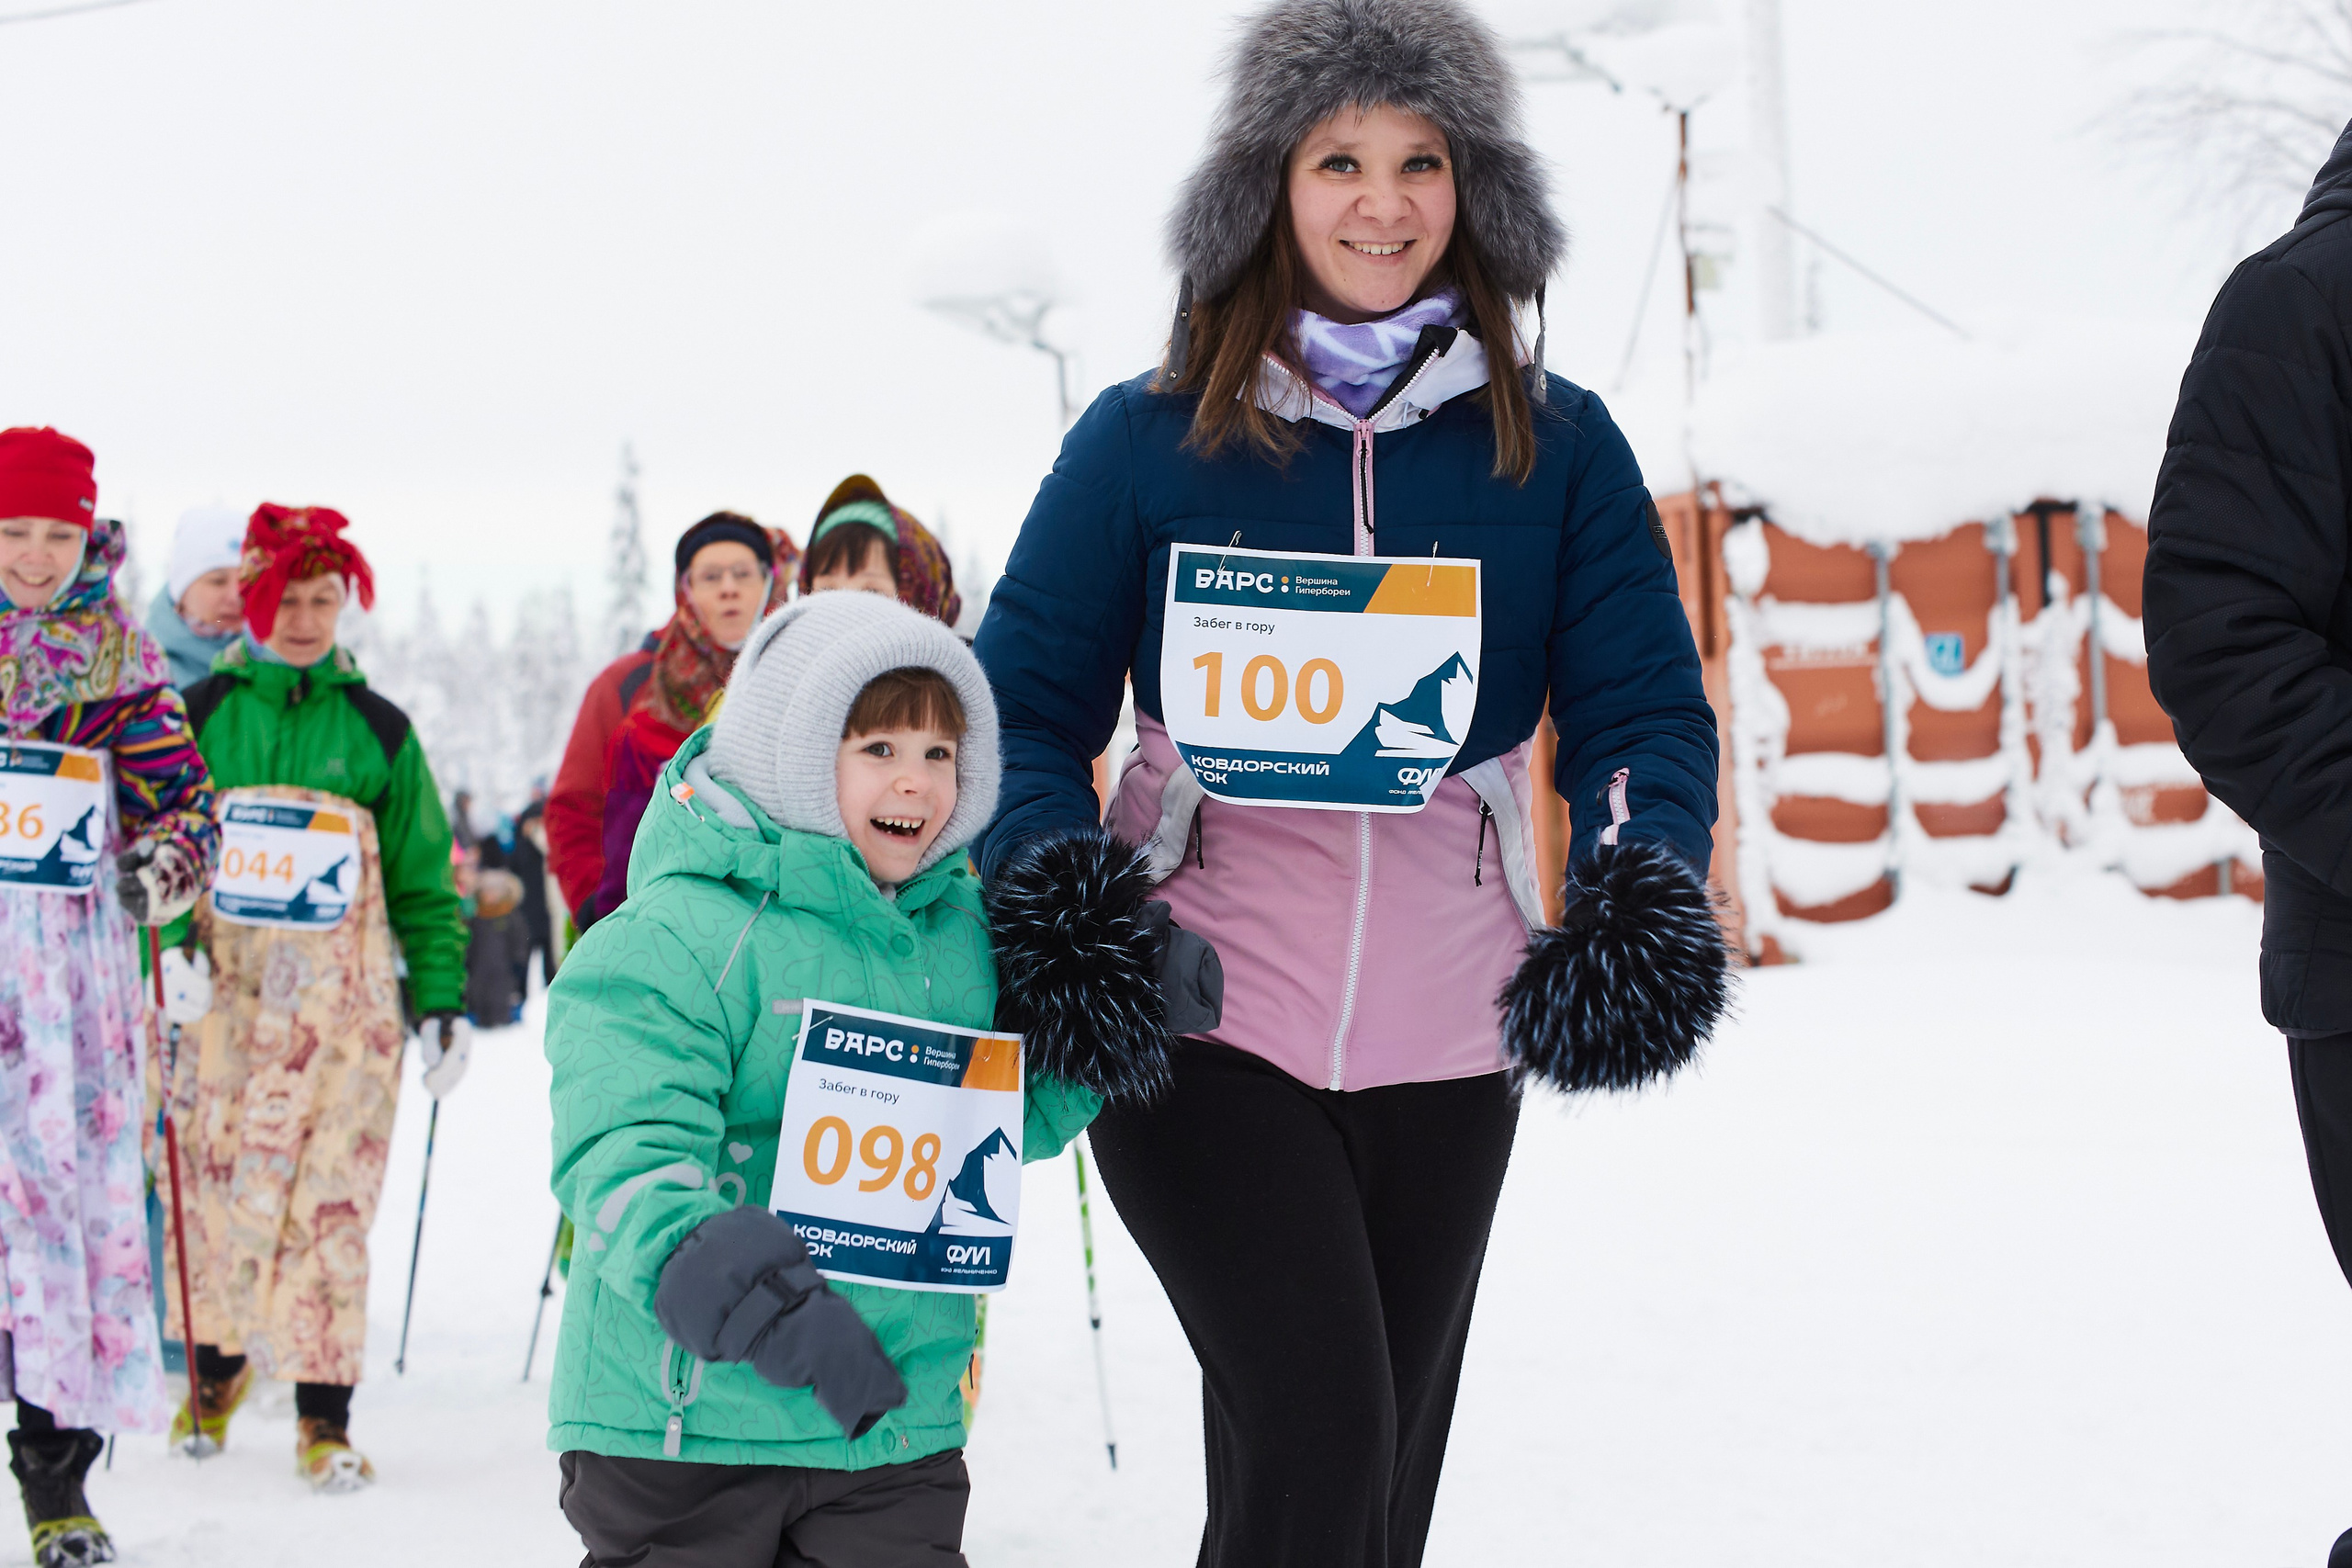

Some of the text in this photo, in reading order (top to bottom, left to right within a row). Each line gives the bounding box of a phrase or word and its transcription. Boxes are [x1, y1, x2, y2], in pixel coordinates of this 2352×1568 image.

[1195, 568, 1274, 593] ВАРС
[1295, 576, 1338, 586] Вершина
[1295, 586, 1351, 596] Гипербореи
[1193, 616, 1275, 635] Забег в гору
[1193, 651, 1344, 725] 100
[1191, 754, 1330, 776] КОВДОРСКИЙ
[1194, 768, 1227, 784] ГОК
[224, 847, 294, 885] 044
[824, 1028, 904, 1062] ВАРС
[819, 1078, 900, 1105] Забег в гору
[802, 1115, 942, 1201] 098
[793, 1224, 917, 1255] КОВДОРСКИЙ
[806, 1242, 833, 1258] ОК
